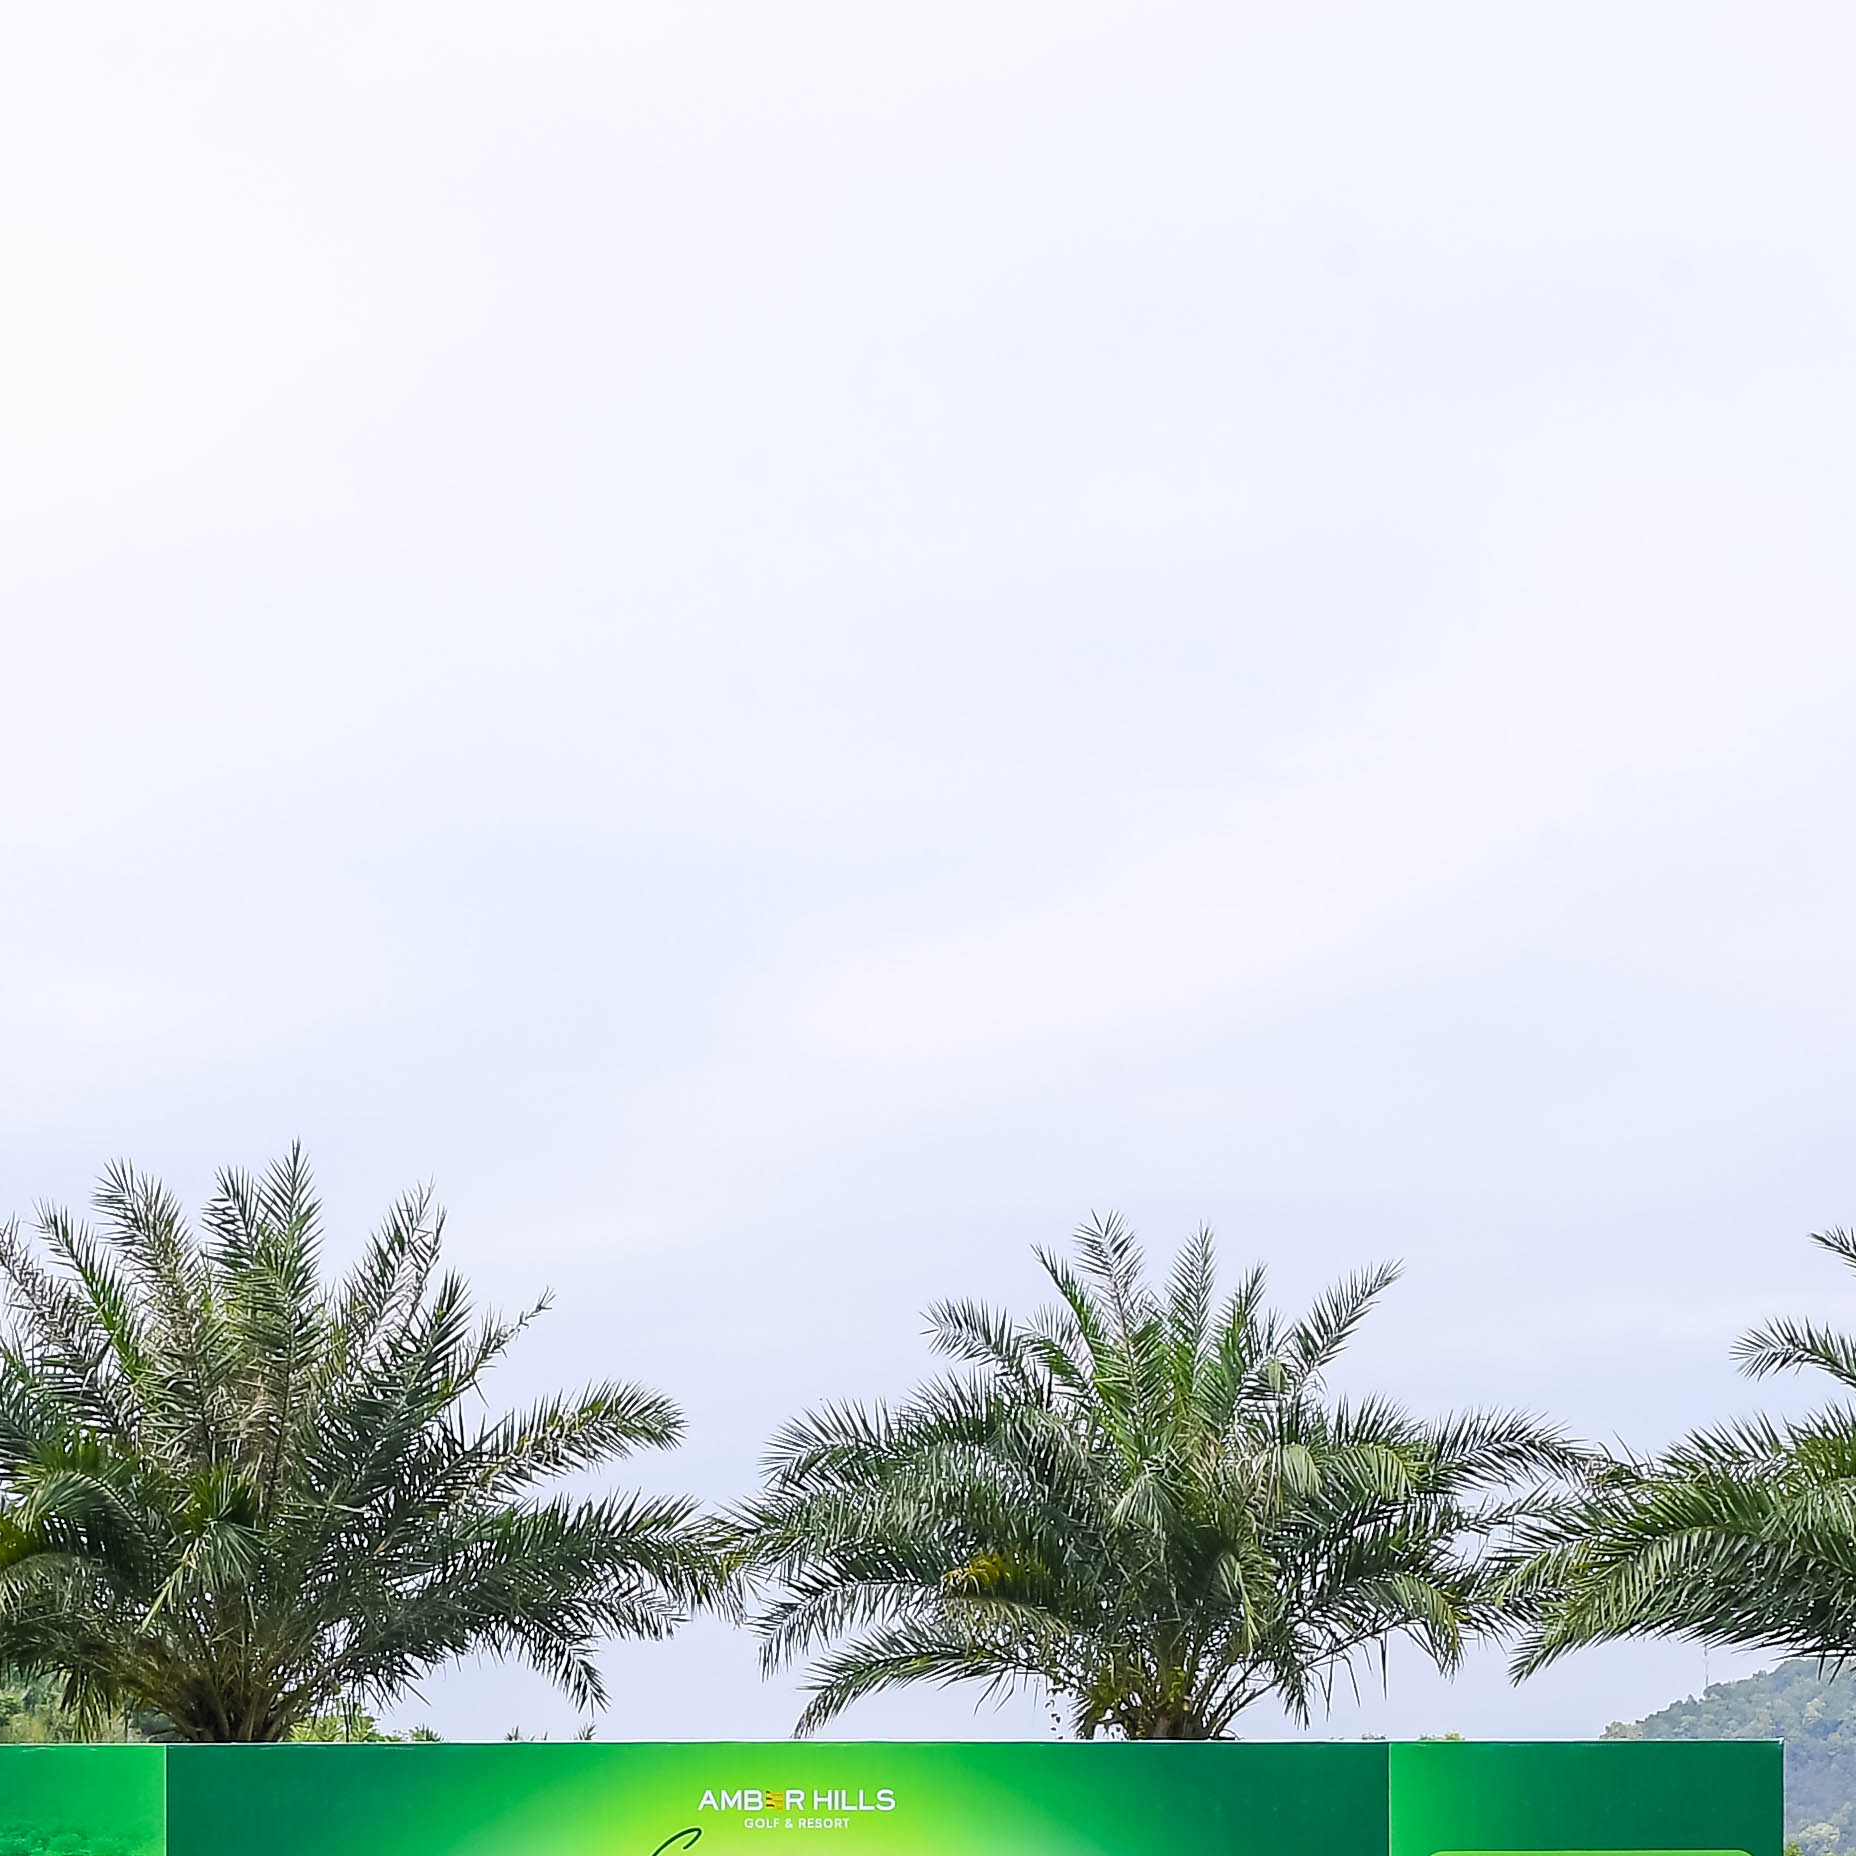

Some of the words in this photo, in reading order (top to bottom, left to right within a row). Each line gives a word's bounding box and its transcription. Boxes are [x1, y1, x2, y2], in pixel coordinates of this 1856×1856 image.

[698, 1789, 805, 1812] AMBER
[813, 1788, 896, 1812] HILLS
[744, 1818, 780, 1829] GOLF
[785, 1818, 793, 1829] &
[798, 1818, 850, 1829] RESORT
